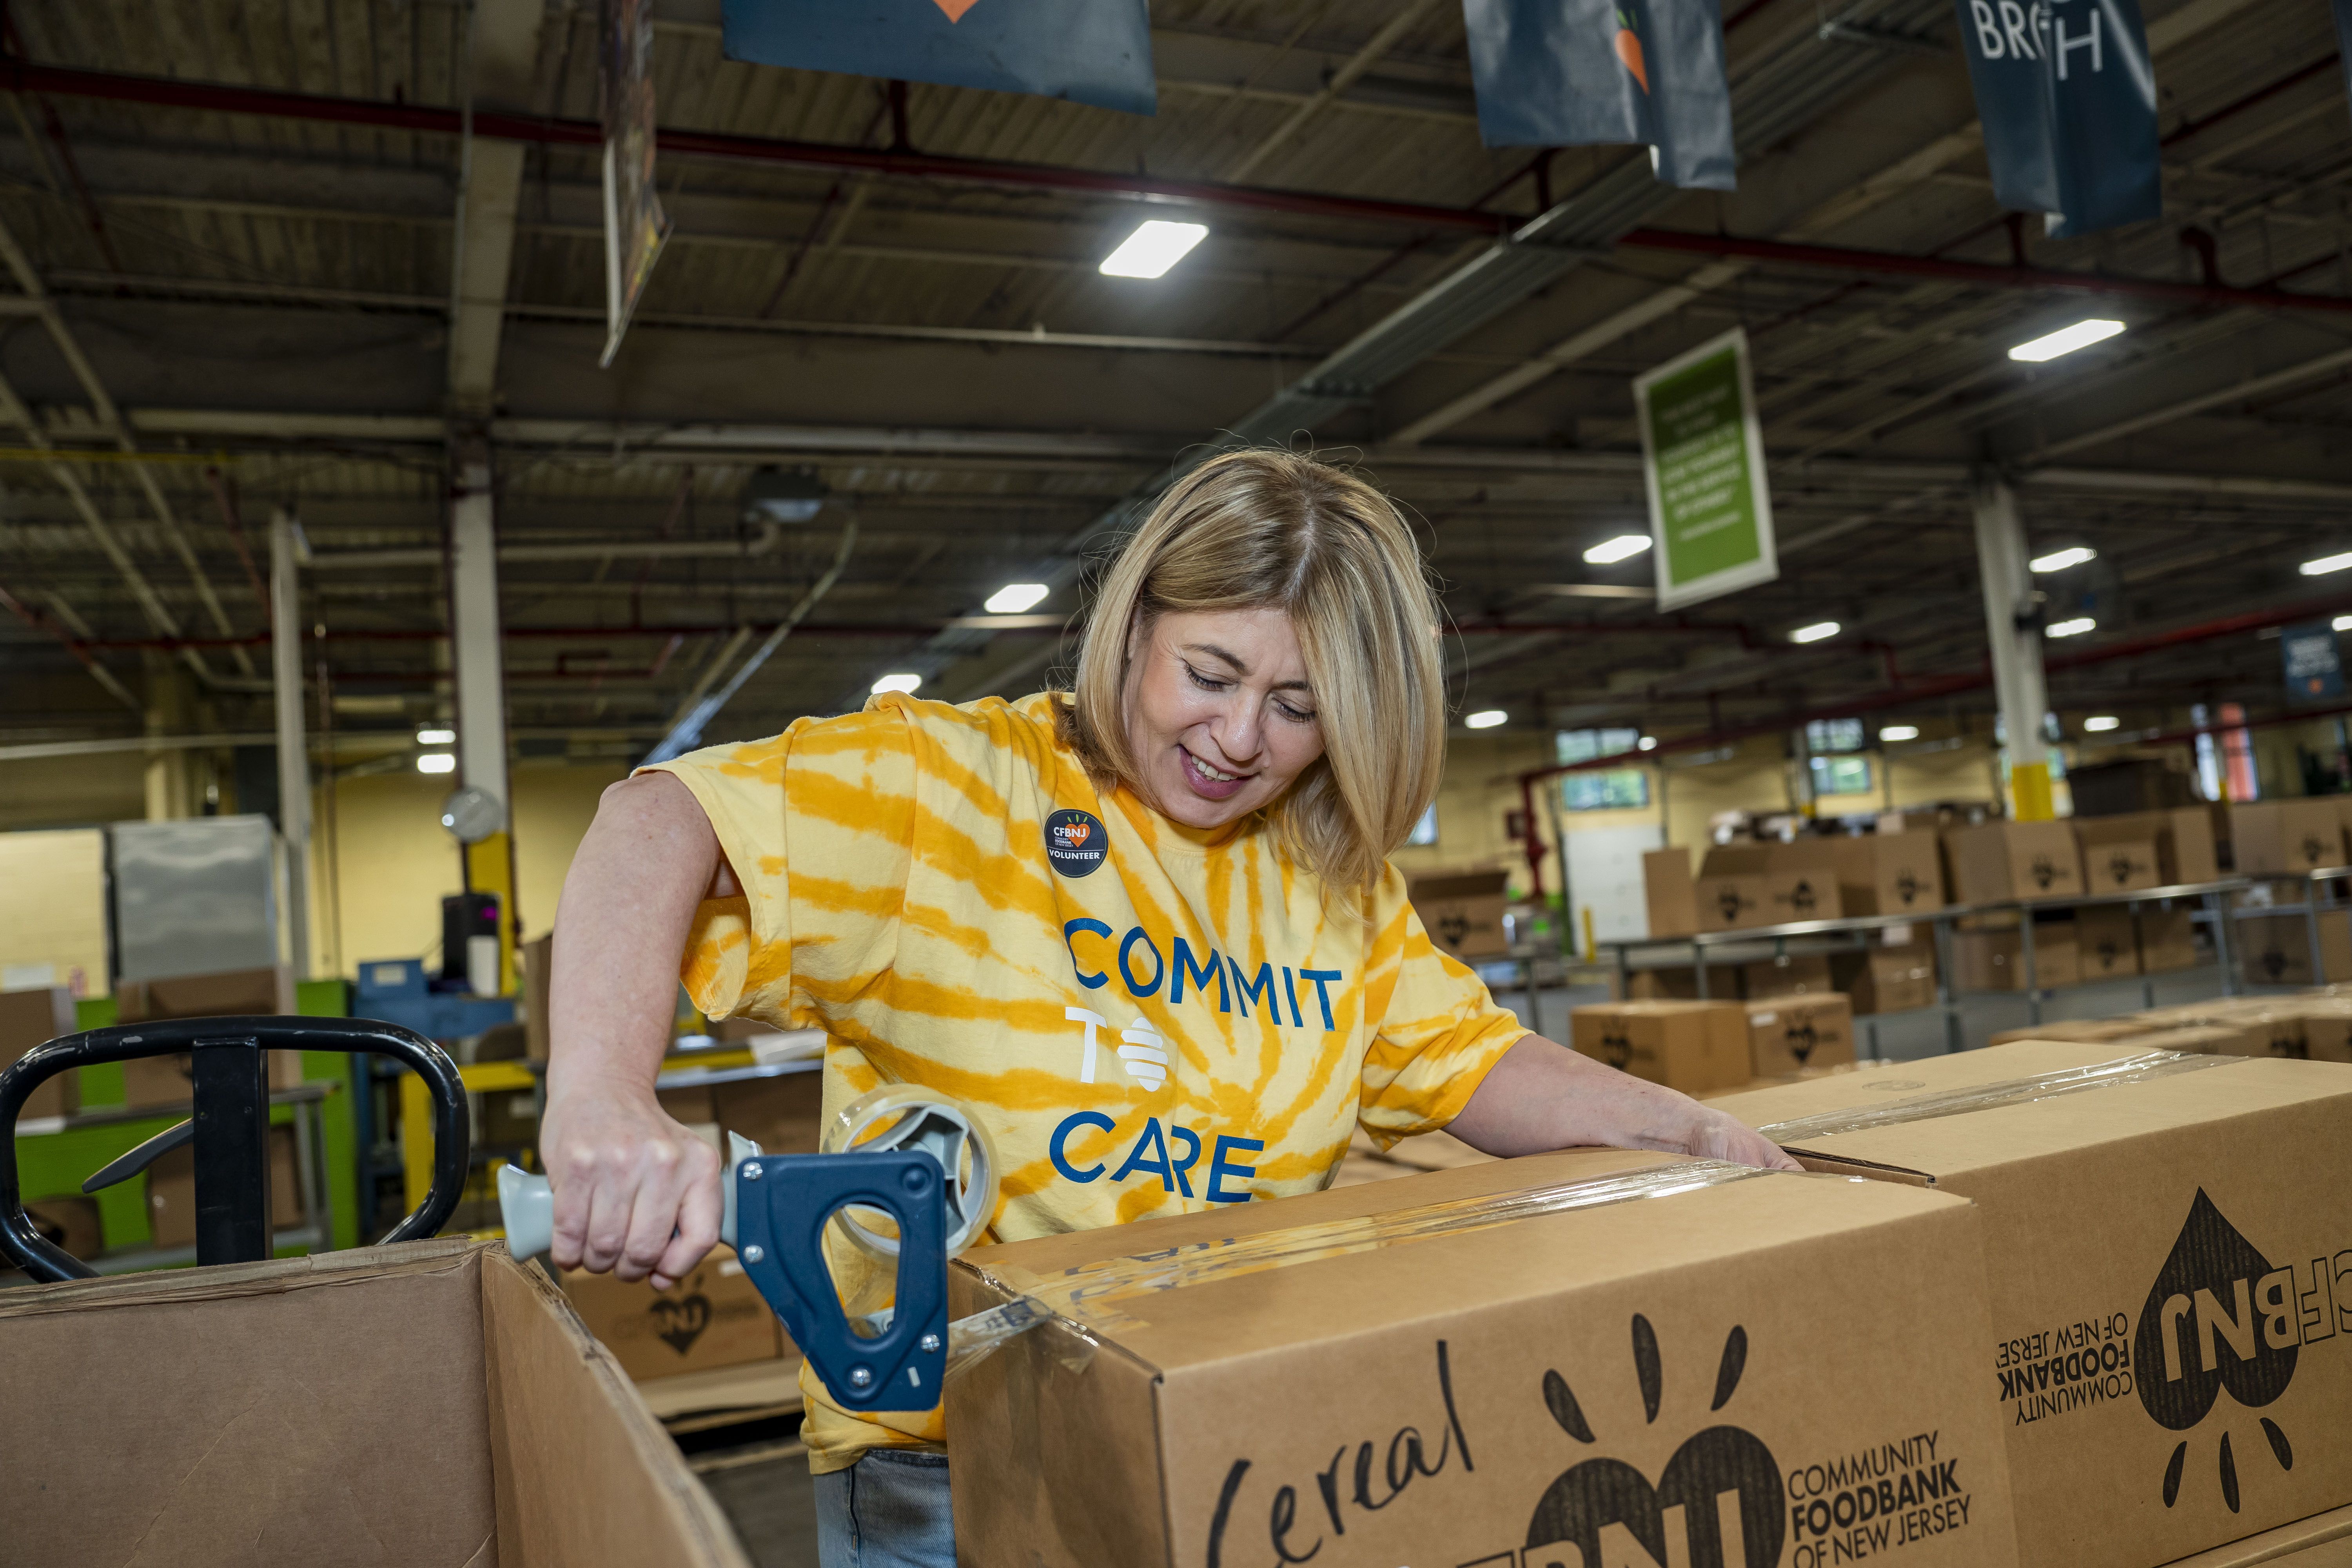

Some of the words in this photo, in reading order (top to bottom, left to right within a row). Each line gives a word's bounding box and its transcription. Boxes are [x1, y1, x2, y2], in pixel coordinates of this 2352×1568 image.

[1049, 849, 1100, 859] VOLUNTEER
[1054, 827, 1086, 837] CFBNJ
[1063, 917, 1342, 1032] COMMIT
[1049, 1111, 1265, 1203] CARE
[2054, 1318, 2100, 1354] NEW
[2103, 1312, 2128, 1340] OF
[1996, 1338, 2130, 1402] FOODBANK
[2015, 1371, 2133, 1426] COMMUNITY
[1206, 1339, 1474, 1568] Cereal
[1788, 1429, 1938, 1500] COMMUNITY
[1791, 1457, 1962, 1542] FOODBANK
[1793, 1539, 1828, 1568] OF
[1832, 1517, 1891, 1566] NEW
[1896, 1493, 1971, 1546] JERSEY
